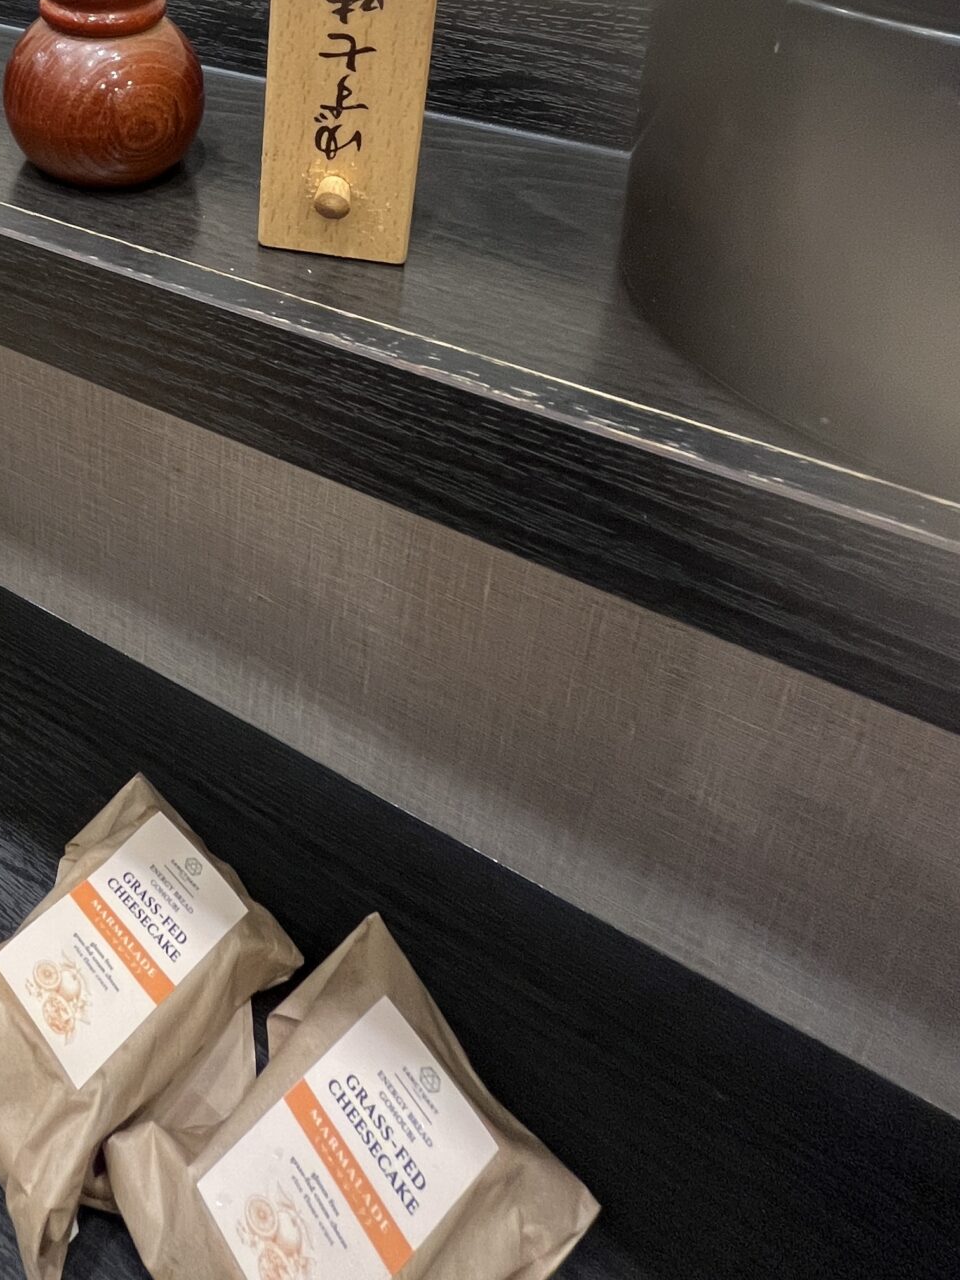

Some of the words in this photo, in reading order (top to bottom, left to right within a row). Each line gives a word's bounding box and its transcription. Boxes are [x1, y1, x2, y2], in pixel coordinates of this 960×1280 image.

[104, 875, 182, 964] CHEESECAKE
[120, 869, 189, 947] GRASS-FED
[148, 862, 175, 893] ENERGY
[171, 889, 195, 916] BREAD
[89, 896, 158, 979] MARMALADE
[325, 1076, 421, 1217] CHEESECAKE
[343, 1071, 429, 1193] GRASS-FED
[376, 1068, 408, 1113] ENERGY
[405, 1110, 434, 1150] BREAD
[308, 1106, 392, 1235] MARMALADE
